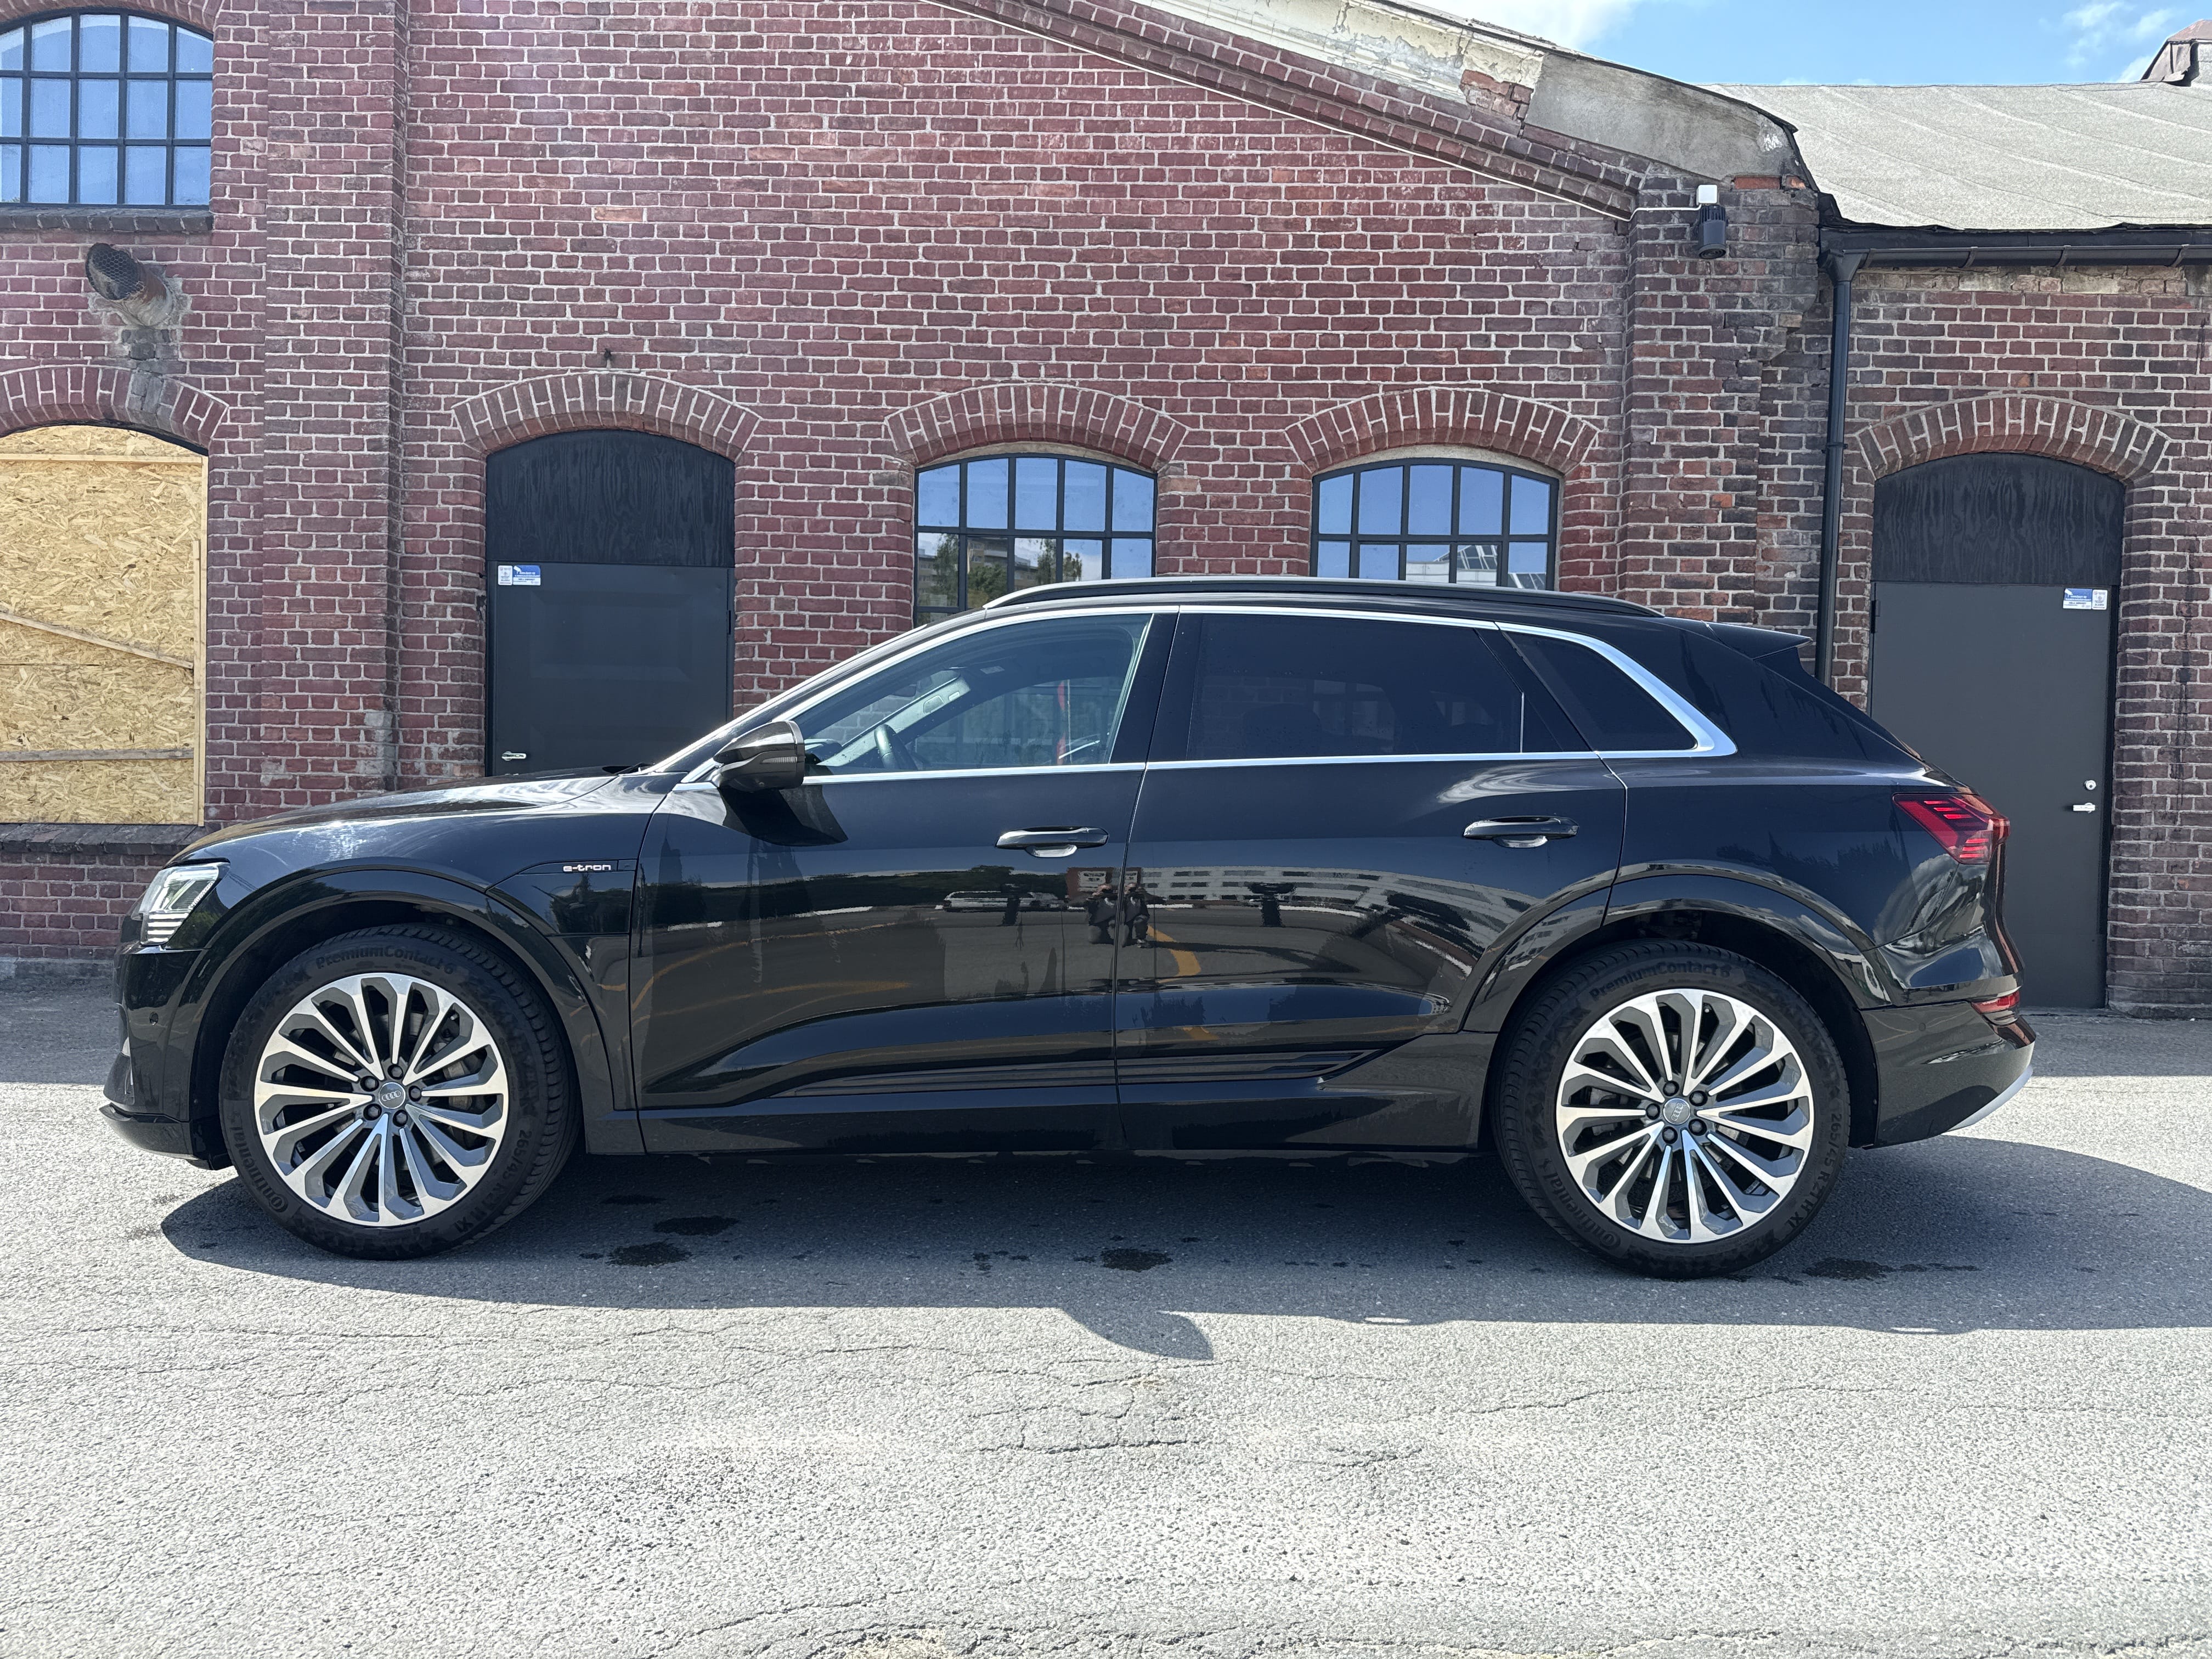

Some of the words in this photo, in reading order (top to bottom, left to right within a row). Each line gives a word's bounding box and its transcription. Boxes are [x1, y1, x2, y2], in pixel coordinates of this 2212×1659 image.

[229, 1126, 289, 1213] Continental
[503, 1130, 532, 1180] 265/45
[1824, 1113, 1843, 1167] 265/45
[1543, 1172, 1621, 1250] Continental
